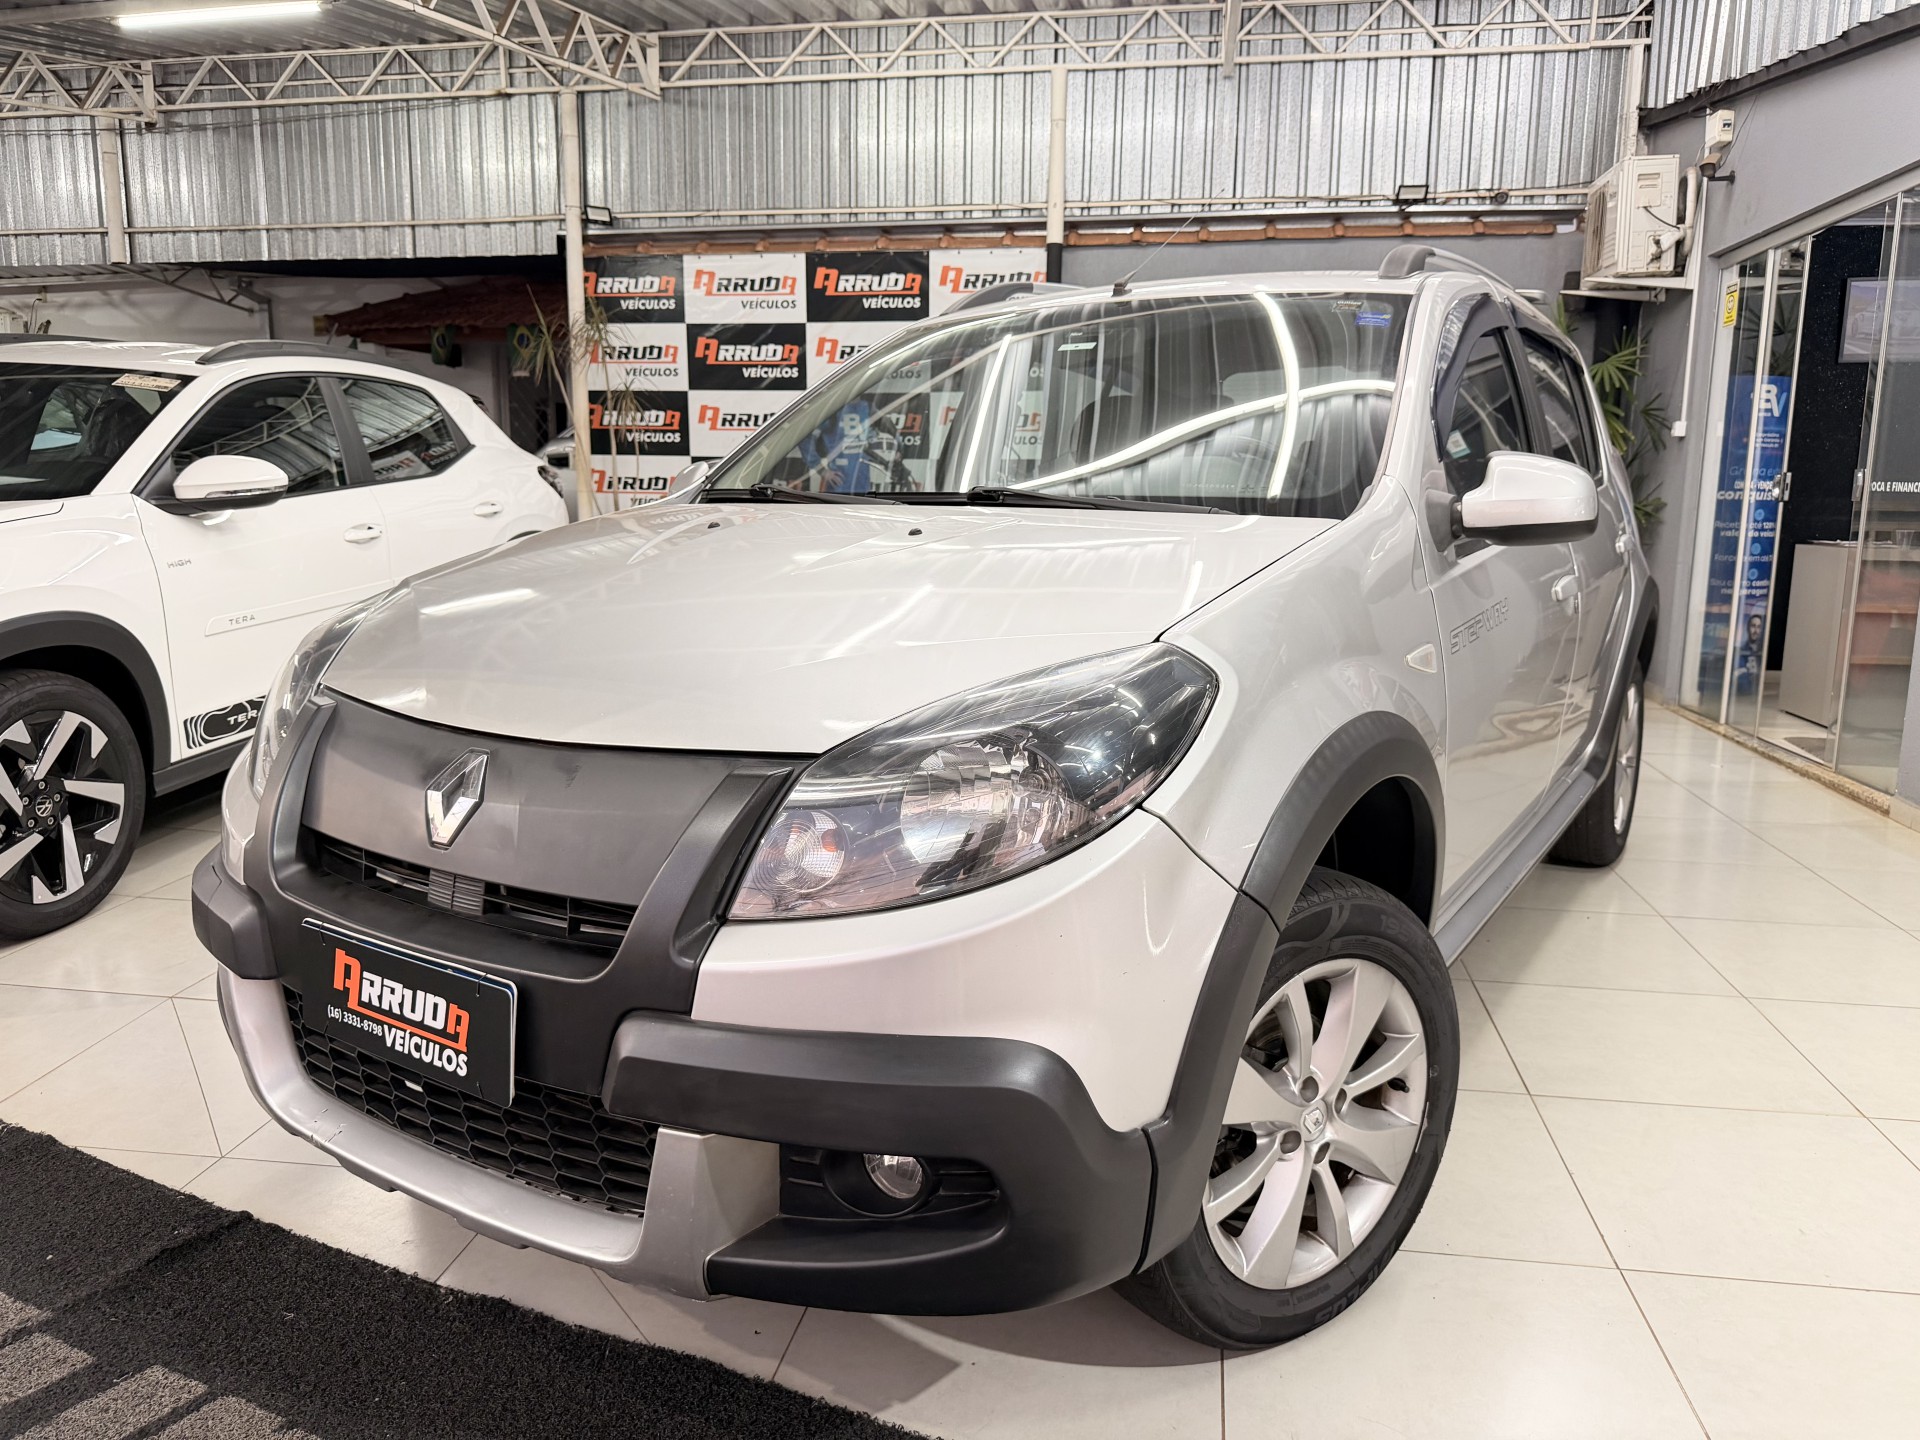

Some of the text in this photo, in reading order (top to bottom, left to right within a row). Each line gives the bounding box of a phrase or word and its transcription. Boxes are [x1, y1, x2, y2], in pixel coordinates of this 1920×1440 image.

[693, 269, 797, 296] ARRUDA
[813, 267, 922, 295] ARRUDA
[621, 297, 676, 310] VEÍCULOS
[742, 297, 797, 309] VEÍCULOS
[862, 295, 922, 309] VEÍCULOS
[695, 336, 799, 365] ARRUDA
[625, 365, 679, 377] VEÍCULOS
[742, 365, 799, 379] VEÍCULOS
[626, 430, 681, 443] VEÍCULOS
[1886, 481, 1892, 492] E
[167, 559, 192, 569] HIGH
[228, 614, 256, 625] TERA
[1449, 597, 1509, 655] STEPWAY
[227, 710, 260, 725] TER
[333, 947, 470, 1053] ARRUDA
[327, 1004, 383, 1037] (16) 3331-8798
[383, 1023, 468, 1077] VEÍCULOS
